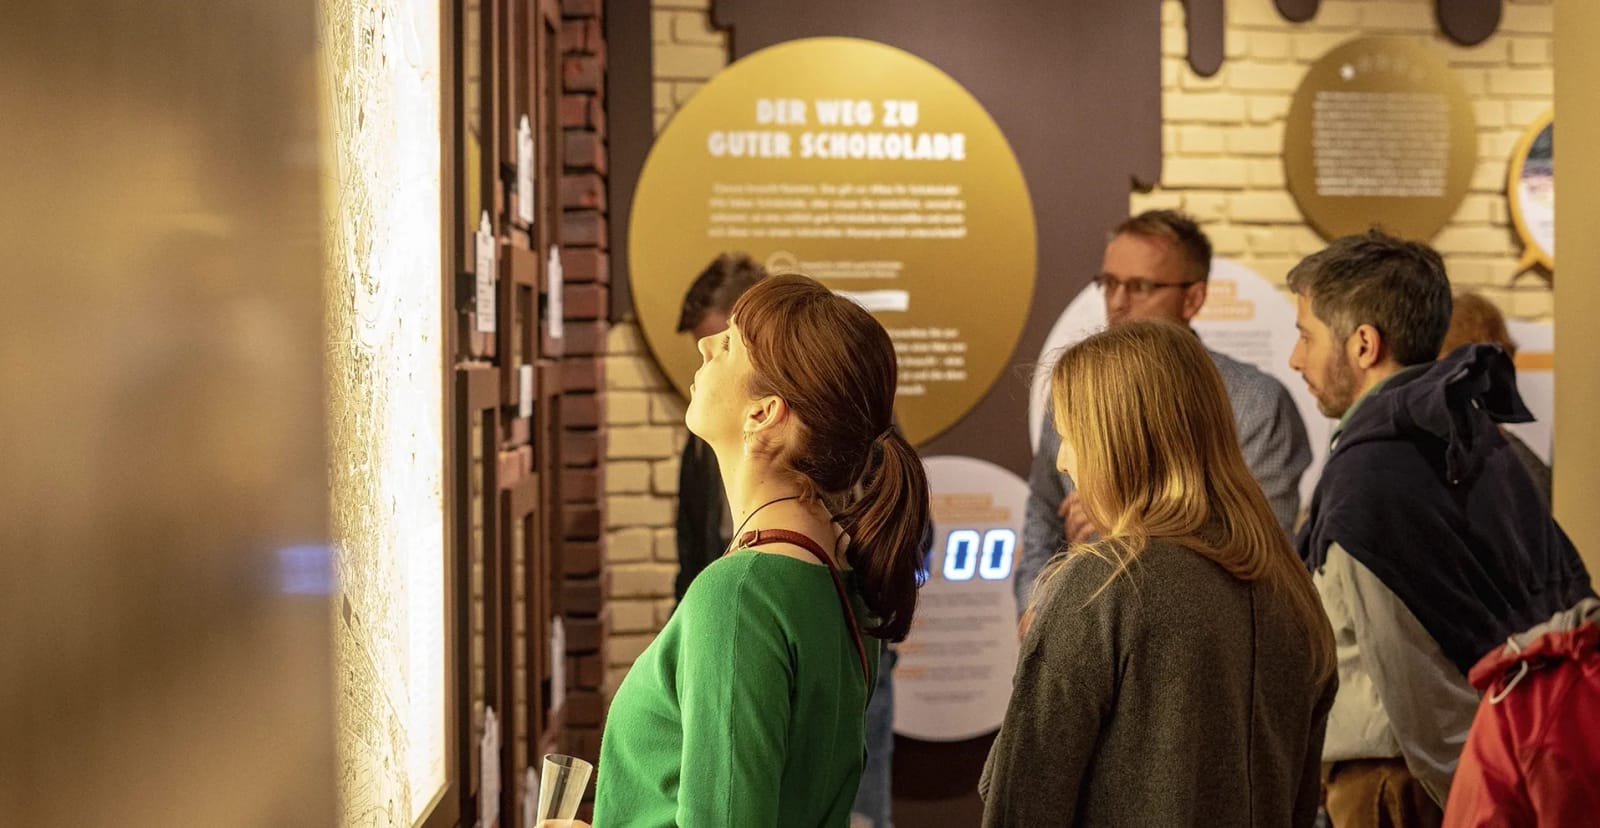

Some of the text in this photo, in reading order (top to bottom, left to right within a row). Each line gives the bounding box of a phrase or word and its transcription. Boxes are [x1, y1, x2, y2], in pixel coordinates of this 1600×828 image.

[757, 99, 918, 127] DER WEG ZU
[707, 131, 965, 160] GUTER SCHOKOLADE
